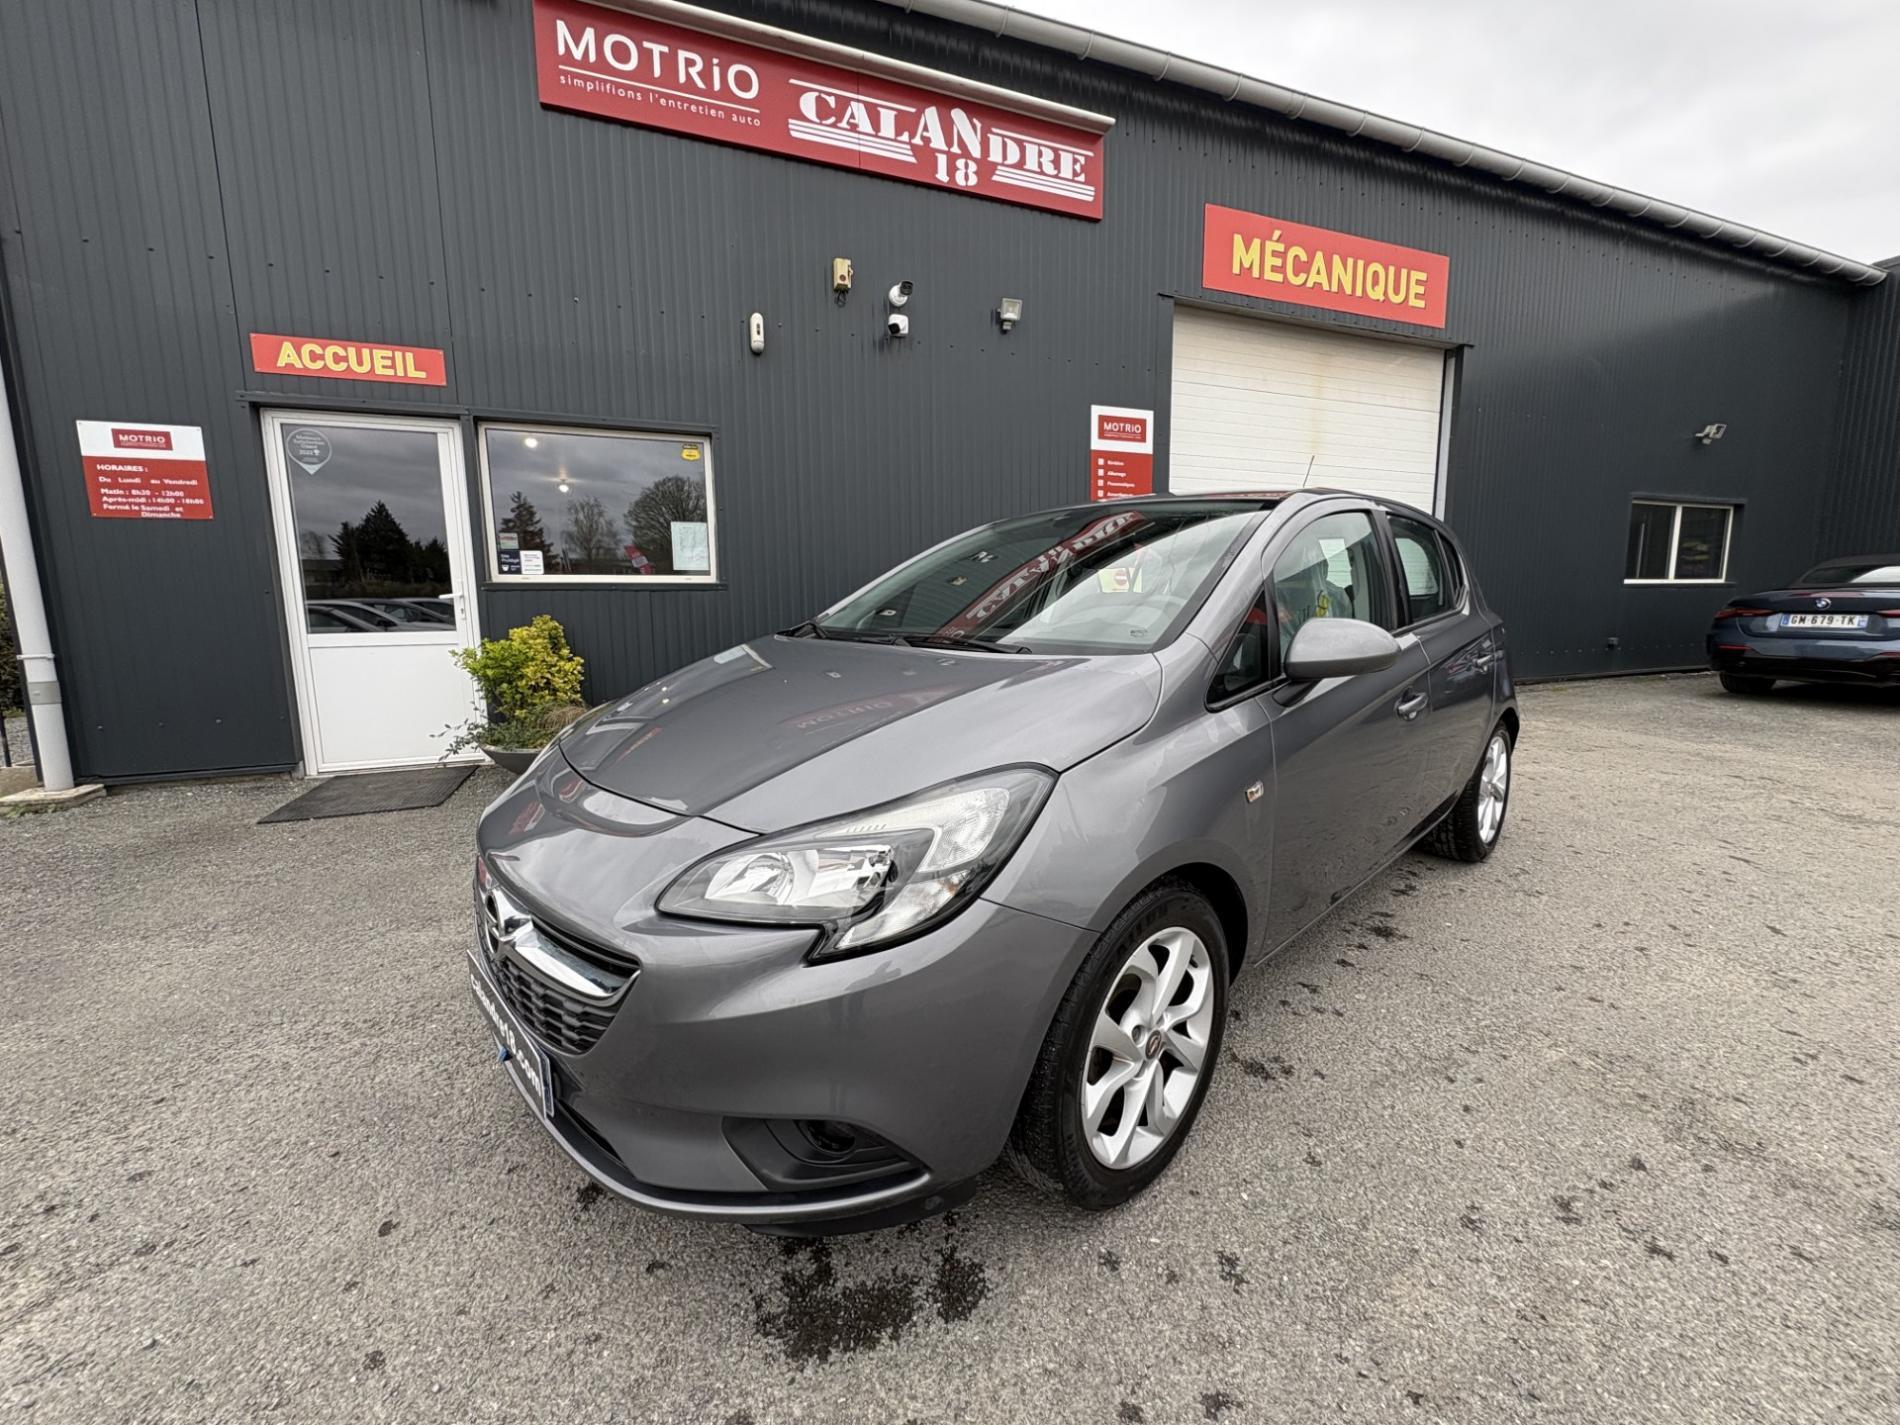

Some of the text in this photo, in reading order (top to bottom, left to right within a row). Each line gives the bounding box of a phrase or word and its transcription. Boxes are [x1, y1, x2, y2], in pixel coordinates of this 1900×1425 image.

[559, 74, 761, 127] simplifions l'entretien auto
[799, 91, 1086, 182] CALANDRE
[935, 152, 978, 187] 18
[1232, 230, 1428, 309] MÉCANIQUE
[277, 341, 427, 379] ACCUEIL
[96, 464, 144, 472] HORAIRES
[162, 478, 198, 486] Vendredi
